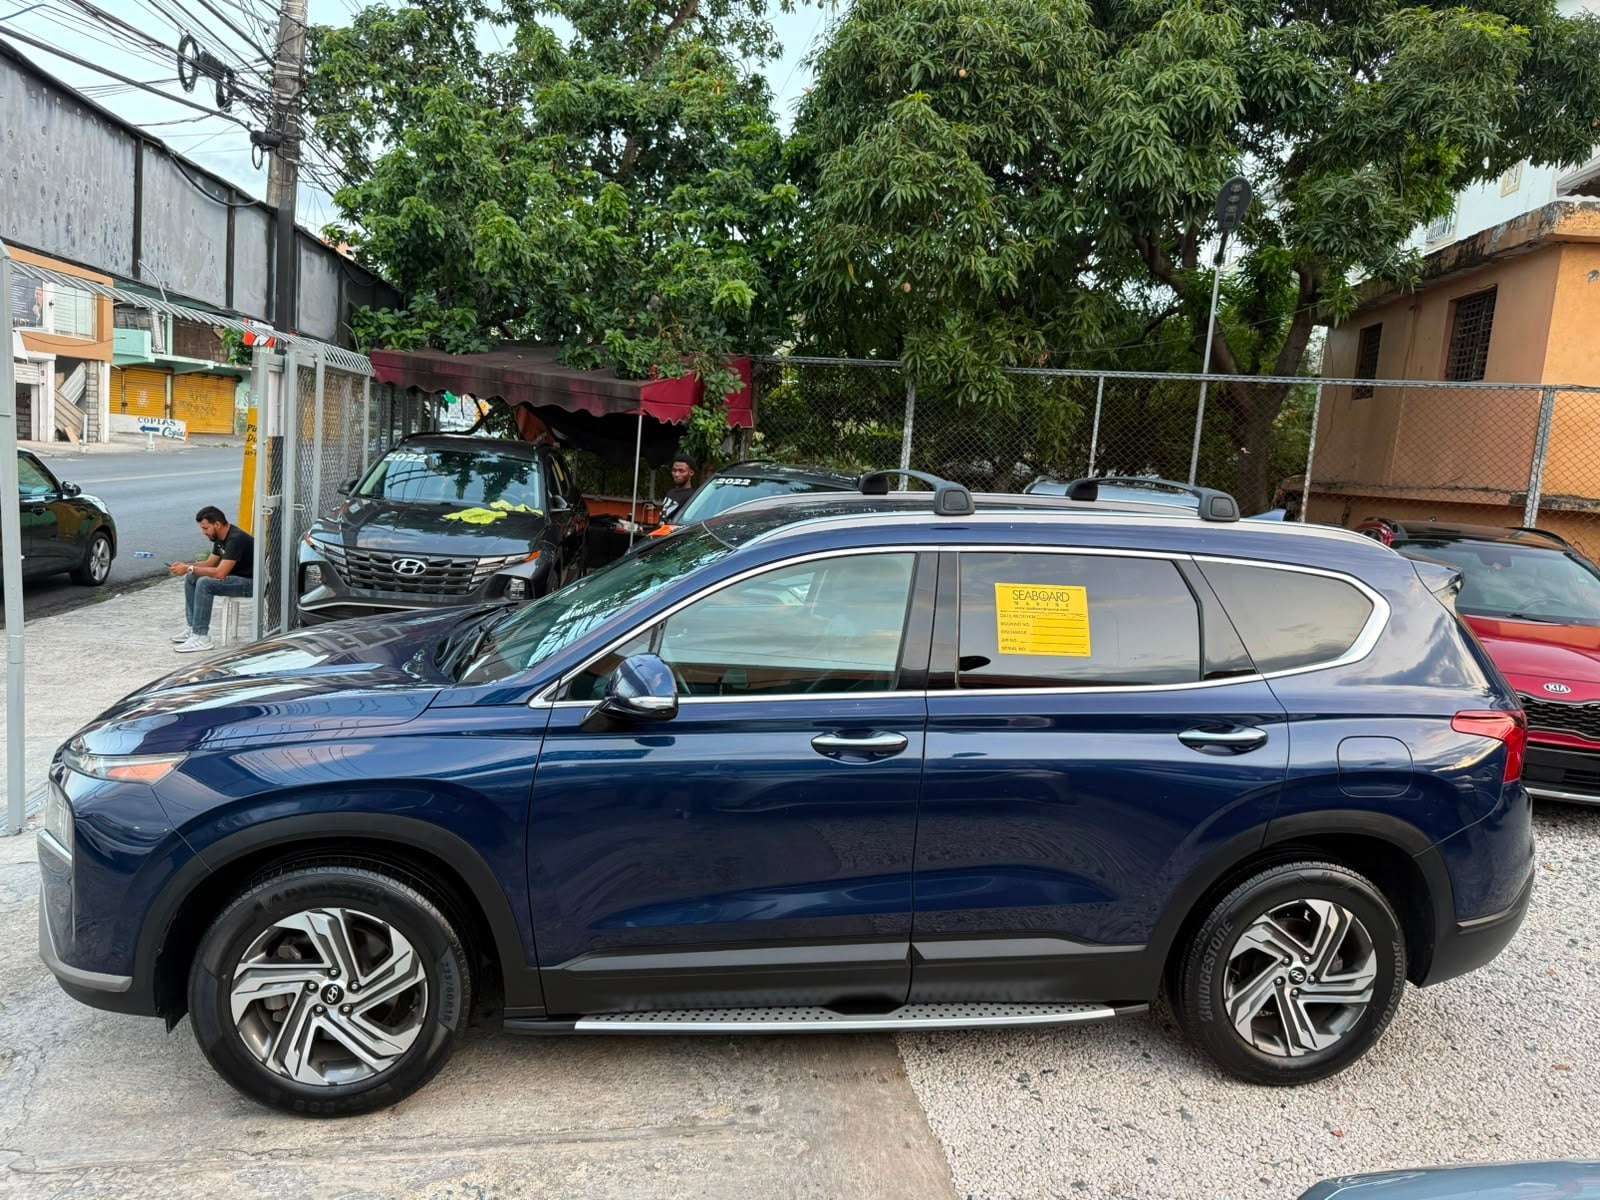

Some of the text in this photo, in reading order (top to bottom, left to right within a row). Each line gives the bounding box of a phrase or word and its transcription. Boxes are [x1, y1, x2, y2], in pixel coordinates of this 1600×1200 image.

[137, 416, 176, 426] COPIAS
[384, 453, 428, 463] 2022
[1012, 589, 1070, 603] SEABOARD
